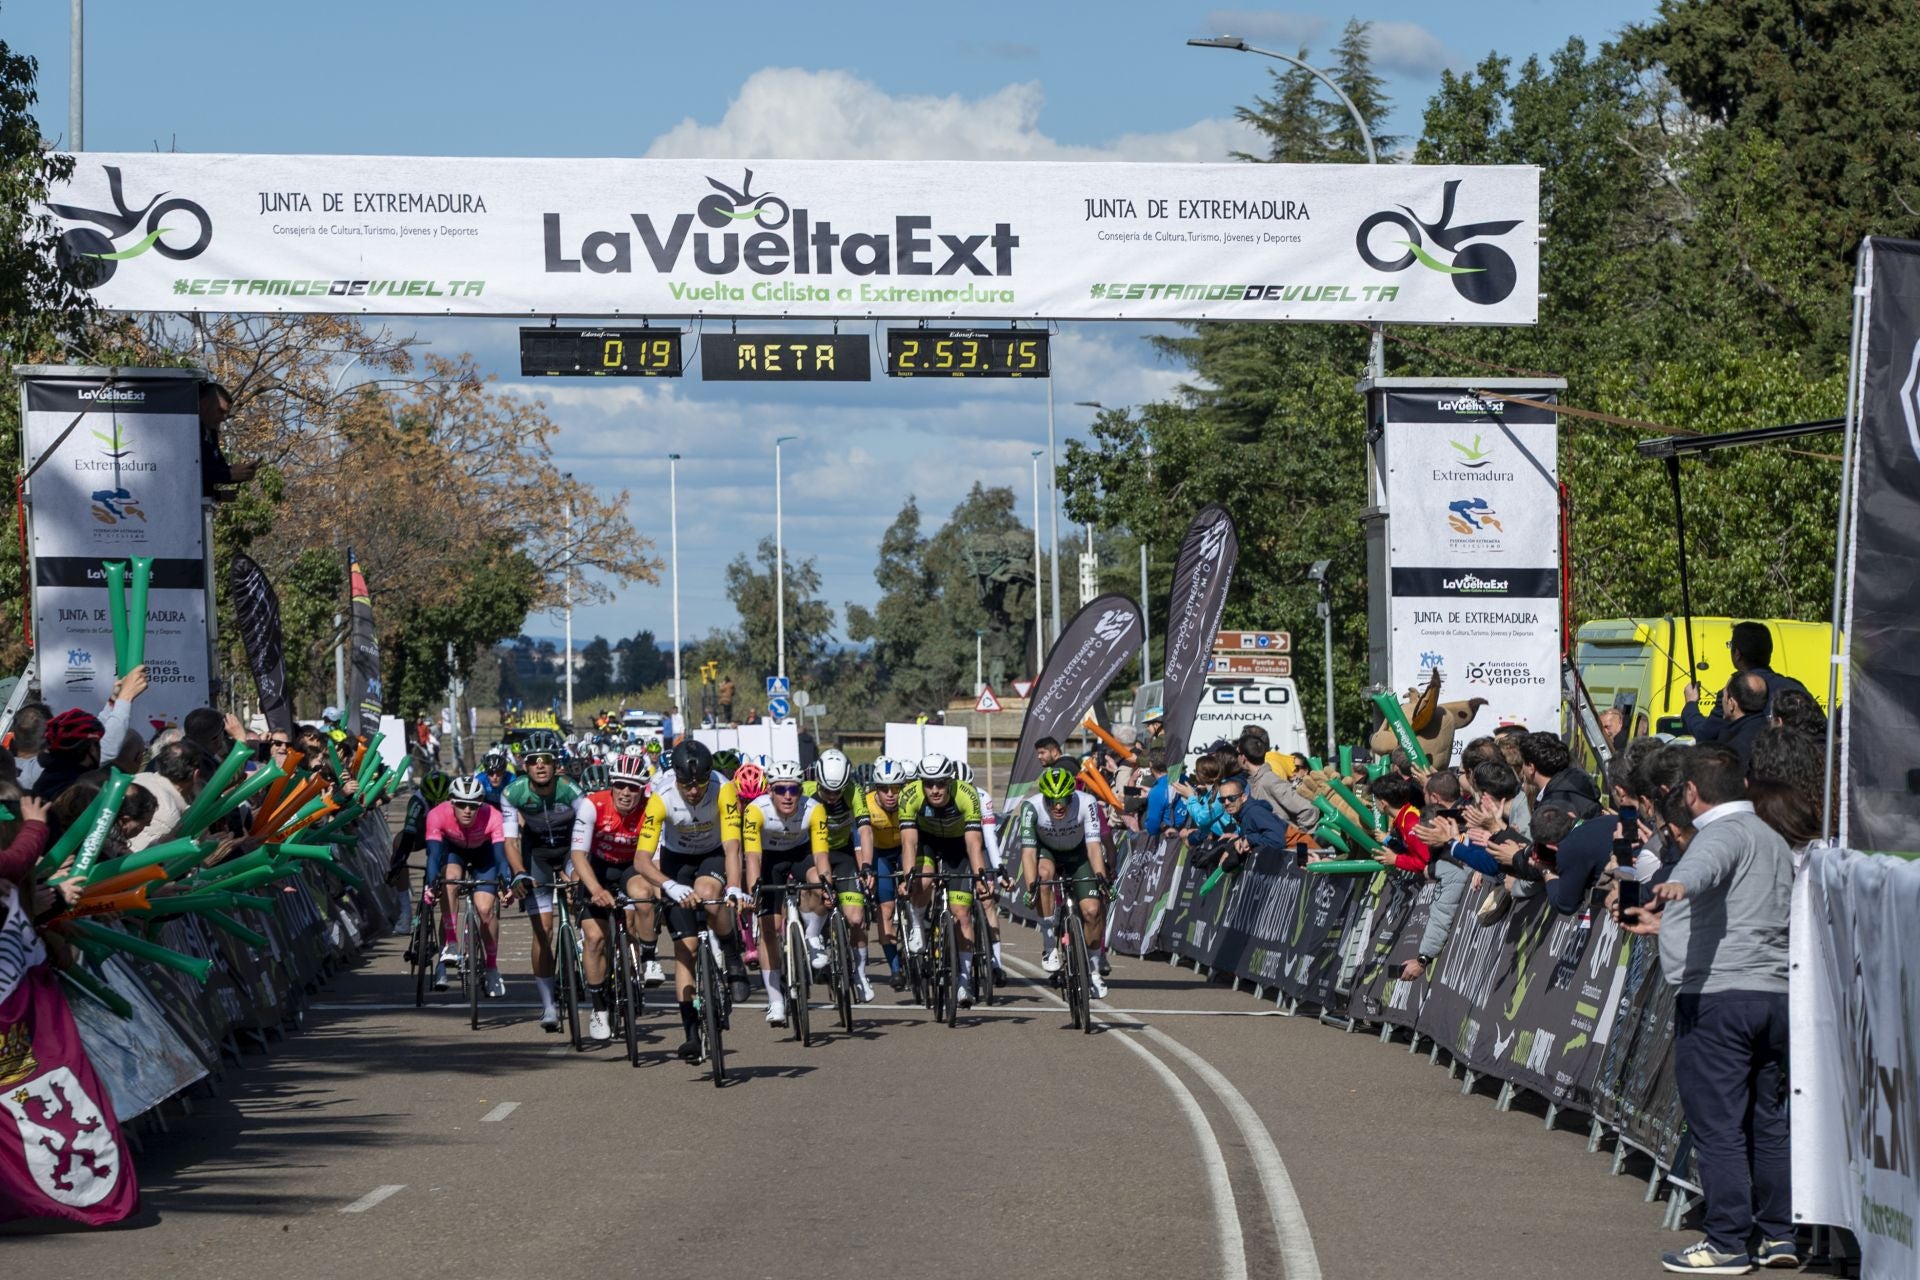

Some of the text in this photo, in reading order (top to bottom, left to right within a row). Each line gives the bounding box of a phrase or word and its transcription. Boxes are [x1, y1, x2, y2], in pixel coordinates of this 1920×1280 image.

[259, 192, 487, 214] JUNTA DE EXTREMADURA
[1085, 198, 1310, 221] JUNTA DE EXTREMADURA
[317, 225, 328, 235] de
[400, 224, 431, 238] Jóvenes
[434, 229, 439, 237] y
[441, 226, 480, 238] Deportes
[1142, 231, 1153, 241] de
[1224, 232, 1253, 244] Jóvenes
[1256, 236, 1261, 244] y
[1263, 232, 1301, 244] Deportes
[543, 208, 1020, 277] LaVueltaExt
[173, 279, 486, 297] #ESTAMOSDEVUELTA
[669, 281, 1015, 304] Vuelta Ciclista a Extremadura
[1090, 283, 1400, 302] #ESTAMOSDEVUELTA
[738, 344, 835, 371] META
[75, 459, 157, 471] Extremadura
[1433, 470, 1514, 481] Extremadura
[1443, 578, 1509, 589] LaVueltaExt
[58, 609, 88, 622] JUNTA
[94, 609, 106, 620] DE
[1414, 612, 1539, 624] JUNTA DE EXTREMADURA
[1032, 637, 1096, 717] FEDERACIÓN EXTREMEÑA
[1055, 641, 1102, 699] CICLISMO
[1465, 665, 1530, 679] jóvenes
